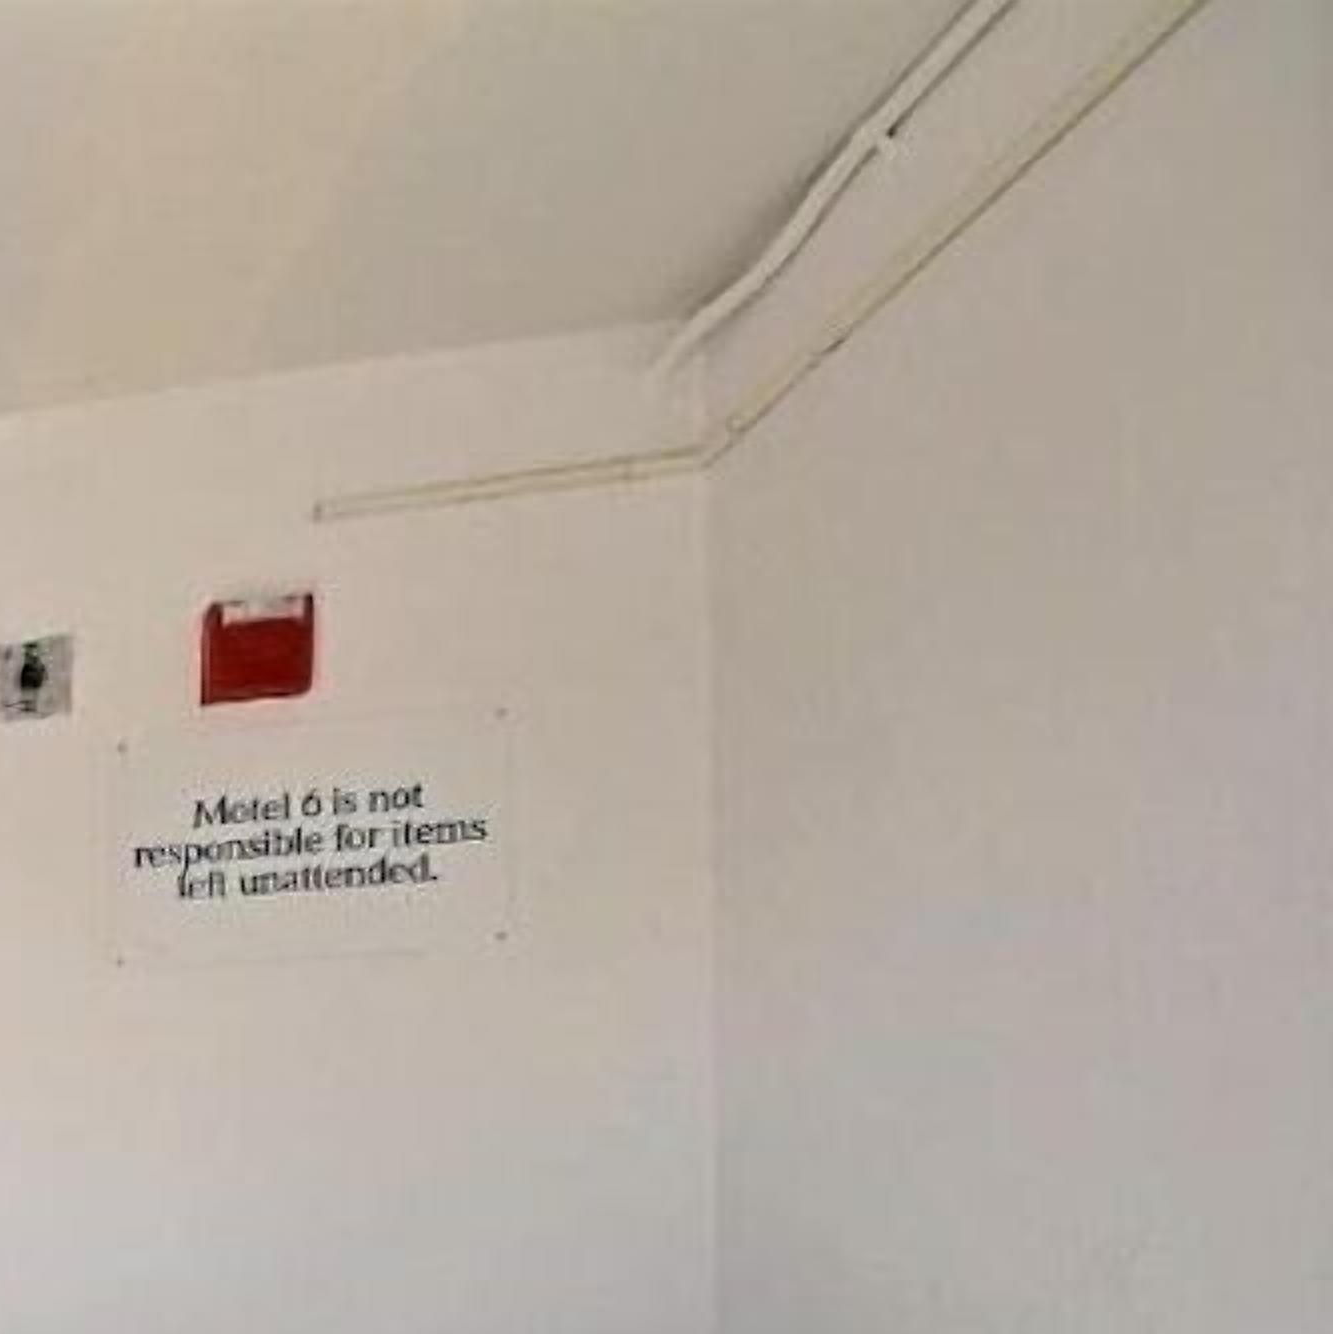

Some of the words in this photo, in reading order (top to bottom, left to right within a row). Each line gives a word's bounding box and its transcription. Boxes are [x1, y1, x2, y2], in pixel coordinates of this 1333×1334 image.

[192, 791, 290, 829] Motel
[301, 788, 323, 817] 6
[332, 786, 357, 816] is
[368, 783, 423, 813] not
[133, 825, 323, 873] responsible
[335, 823, 379, 853] for
[391, 819, 488, 848] items
[178, 869, 226, 898] left
[239, 853, 438, 896] unattended.
